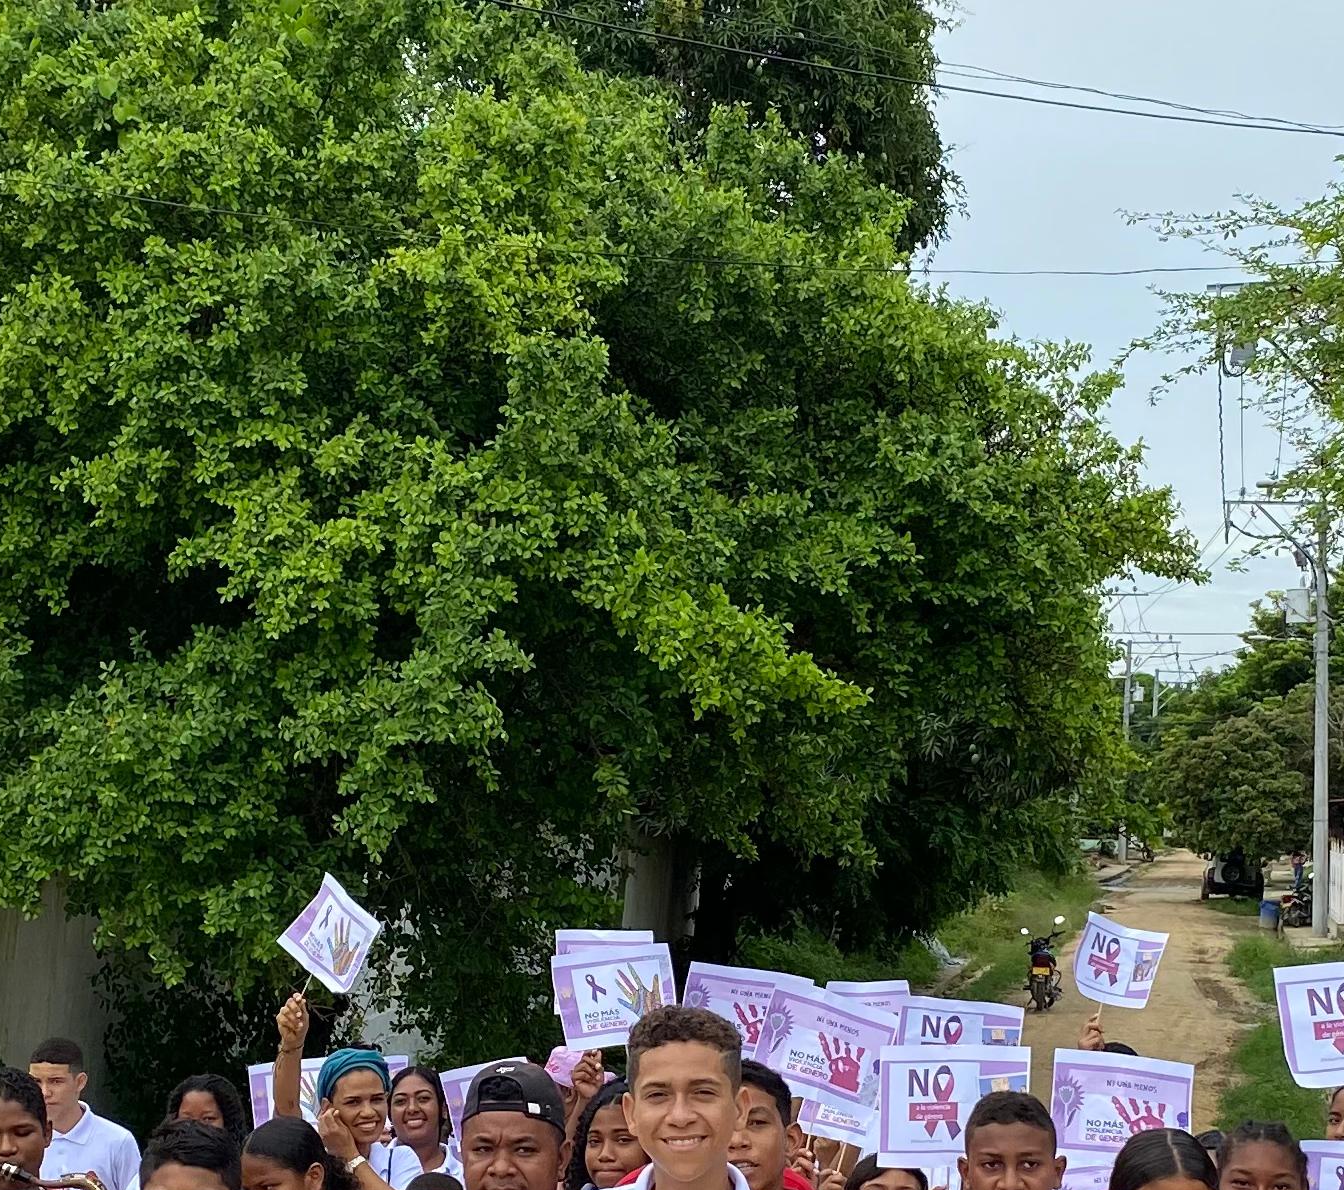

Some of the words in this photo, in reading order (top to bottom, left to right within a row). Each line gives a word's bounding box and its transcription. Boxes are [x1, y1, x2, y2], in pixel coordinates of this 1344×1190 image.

[789, 1049, 805, 1059] NO
[1086, 1119, 1101, 1127] NO
[1085, 1133, 1097, 1141] DE
